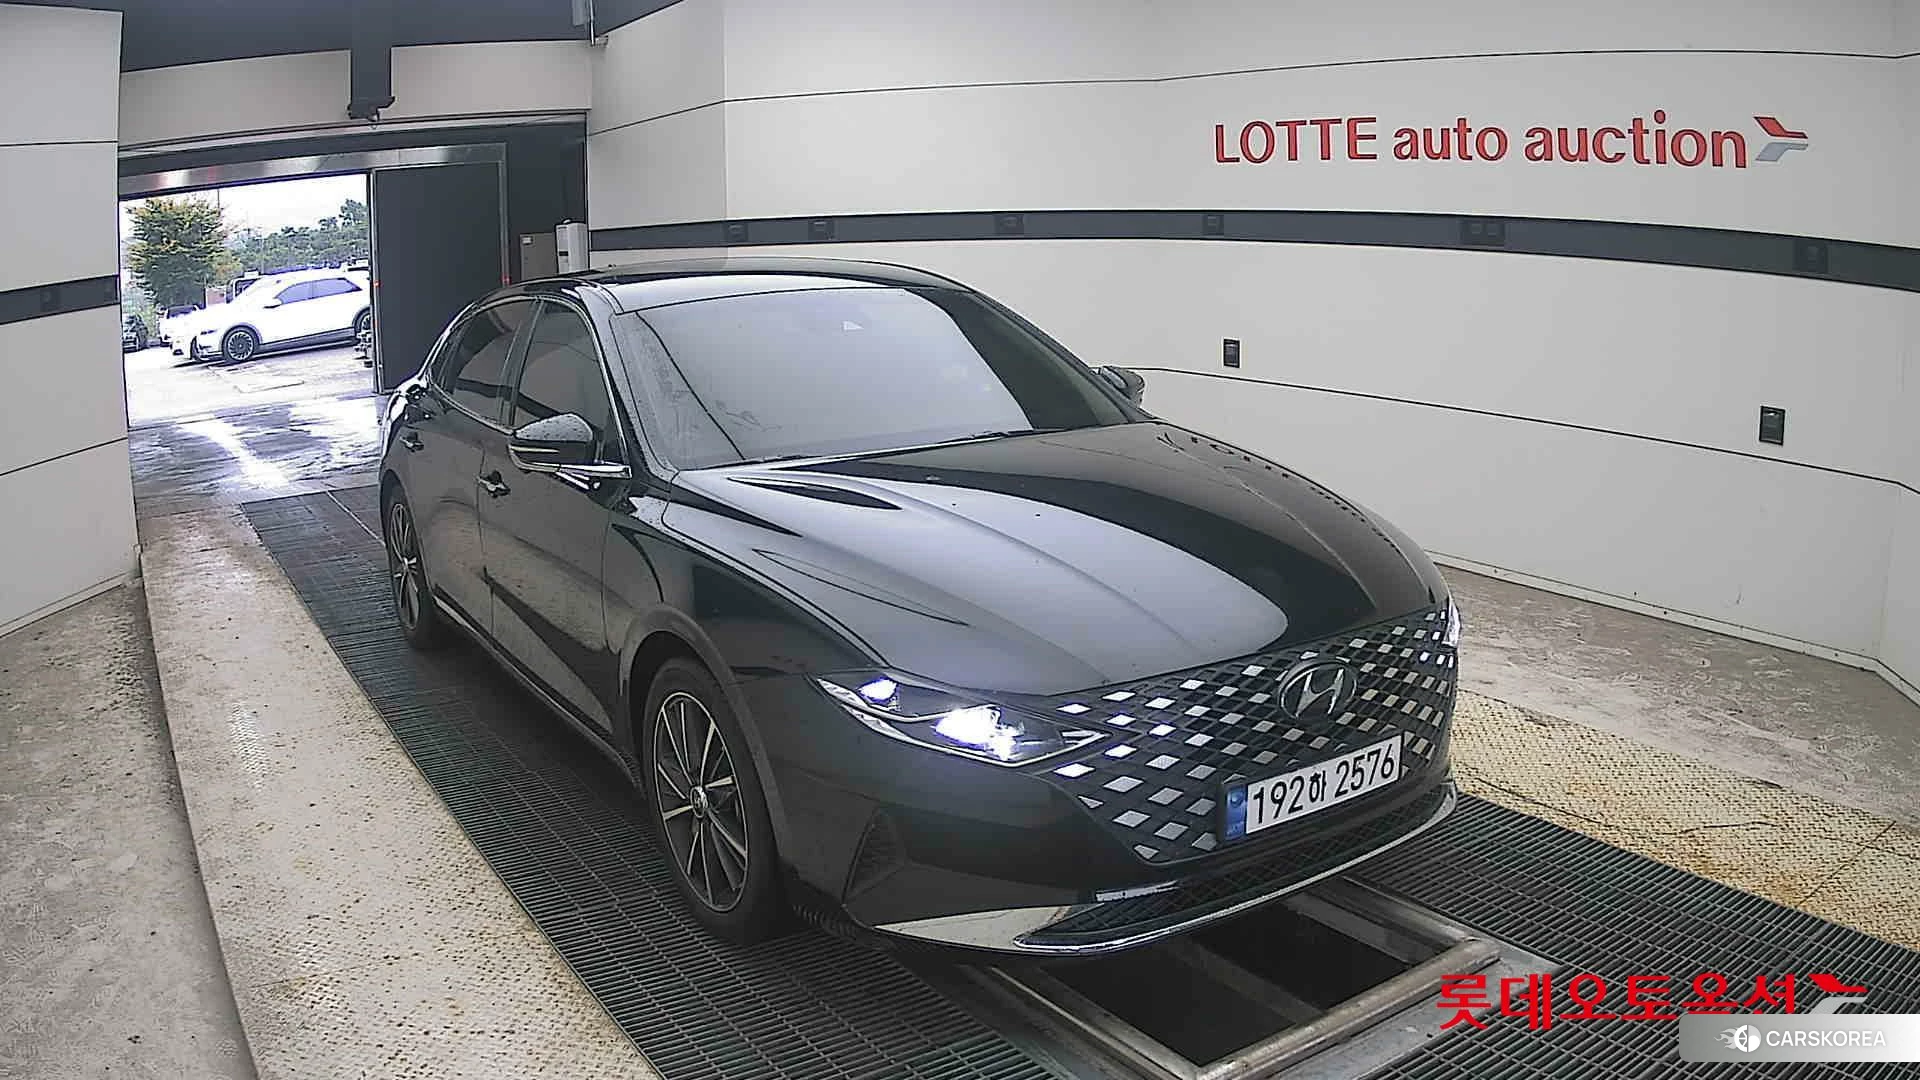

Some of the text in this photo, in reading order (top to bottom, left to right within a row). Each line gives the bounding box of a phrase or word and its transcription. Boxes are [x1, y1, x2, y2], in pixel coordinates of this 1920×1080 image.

[1214, 110, 1748, 168] LOTTE auto auction
[1253, 743, 1395, 824] 192하 2576
